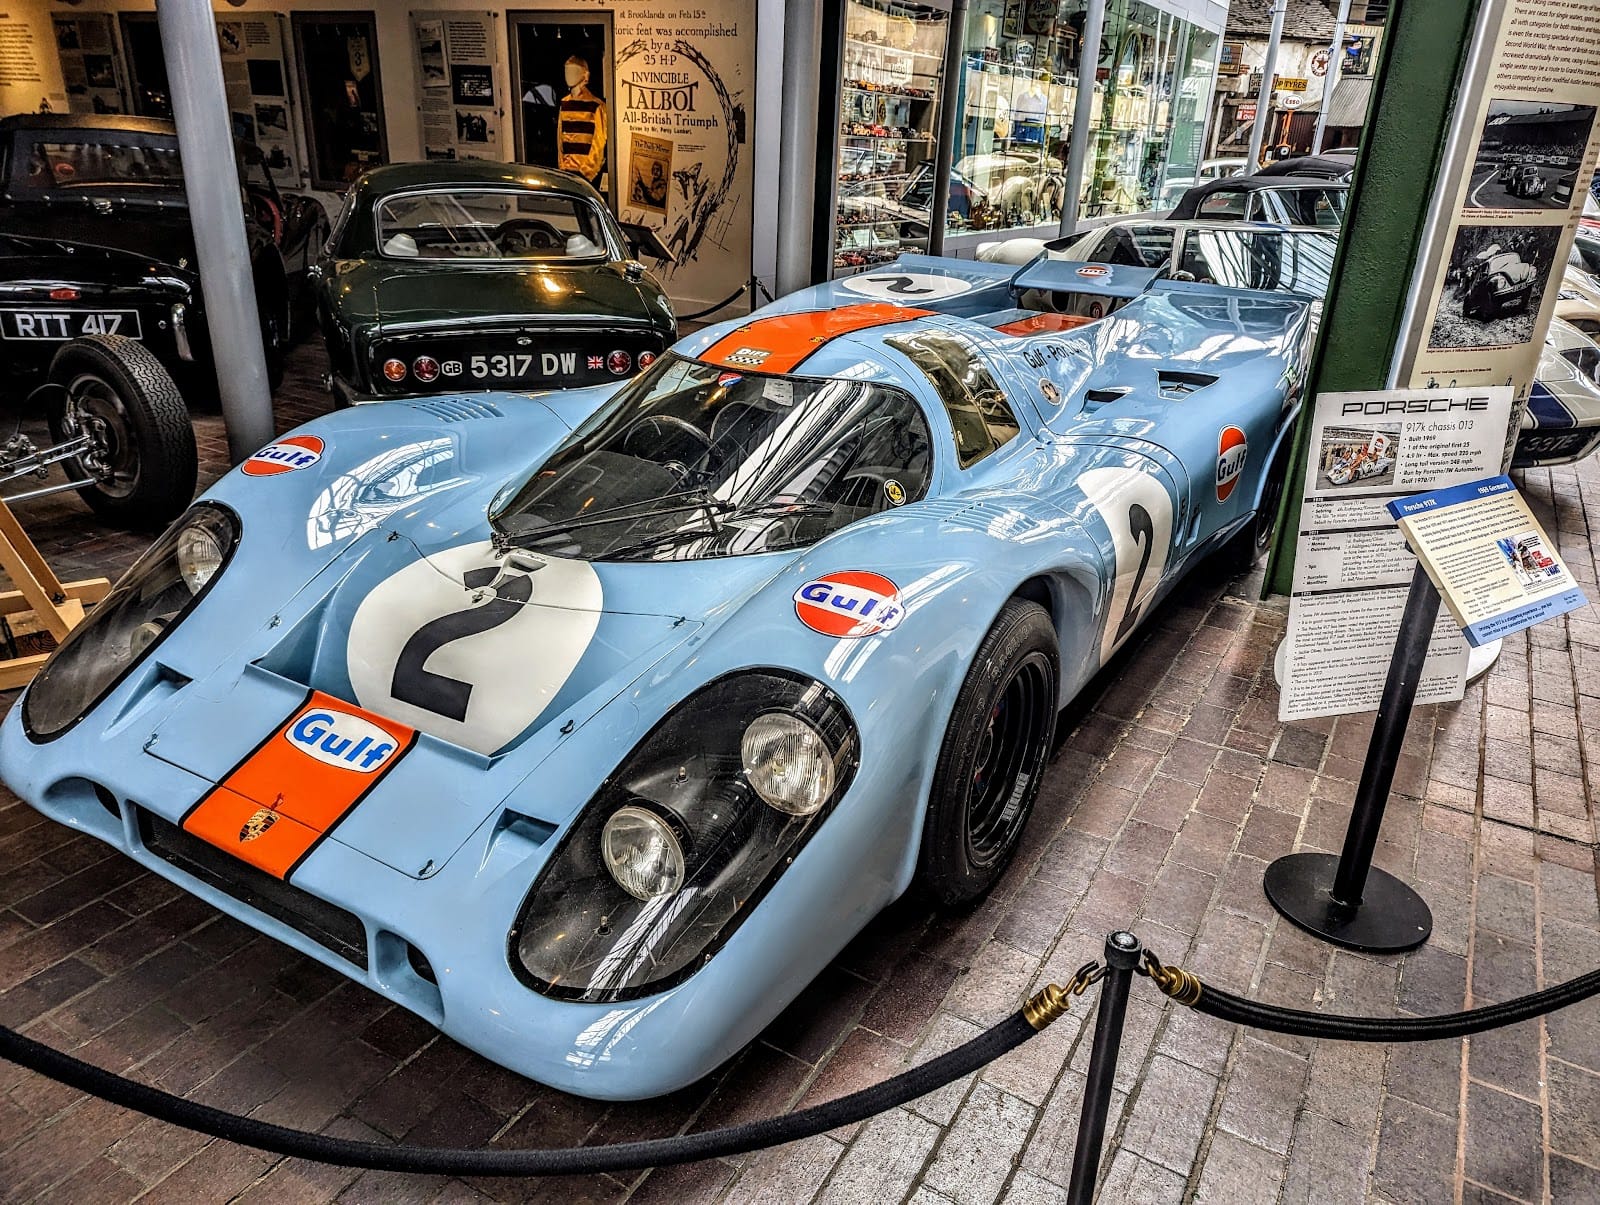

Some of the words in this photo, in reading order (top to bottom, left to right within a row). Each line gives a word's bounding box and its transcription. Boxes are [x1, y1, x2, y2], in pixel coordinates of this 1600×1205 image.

[627, 9, 665, 19] Brooklands
[679, 10, 692, 19] Feb
[636, 23, 652, 36] feat
[656, 28, 672, 36] was
[675, 22, 738, 39] accomplished
[651, 39, 663, 53] by
[664, 42, 670, 50] a
[1505, 40, 1523, 48] Second
[1523, 41, 1537, 49] World
[644, 54, 656, 65] 25
[1503, 51, 1524, 59] increased
[631, 71, 689, 84] INVINCIBLE
[1285, 80, 1307, 89] TYRES
[1494, 83, 1516, 92] enjoyable
[621, 79, 699, 112] TALBOT
[1285, 98, 1300, 106] Esso
[622, 111, 672, 125] All-British
[674, 113, 718, 129] Triumph
[867, 276, 935, 294] 2
[15, 314, 71, 337] RTT
[81, 315, 122, 335] 417
[443, 362, 462, 375] GB
[471, 355, 533, 378] 5317
[541, 352, 577, 376] DW
[1341, 397, 1490, 417] PORSCHE
[1406, 421, 1426, 433] 917k
[1428, 421, 1456, 431] chassis
[1459, 420, 1474, 430] 013
[1429, 442, 1450, 450] original
[254, 446, 316, 467] Gulf
[1441, 450, 1457, 458] speed
[1470, 449, 1482, 457] mph
[1217, 447, 1247, 482] Gulf
[1454, 465, 1484, 473] Automotive
[1489, 483, 1509, 493] Germany
[1403, 501, 1424, 513] Porsche
[1111, 503, 1153, 649] 2
[801, 583, 899, 624] Gulf
[391, 566, 533, 722] 2
[293, 713, 392, 768] Gulf
